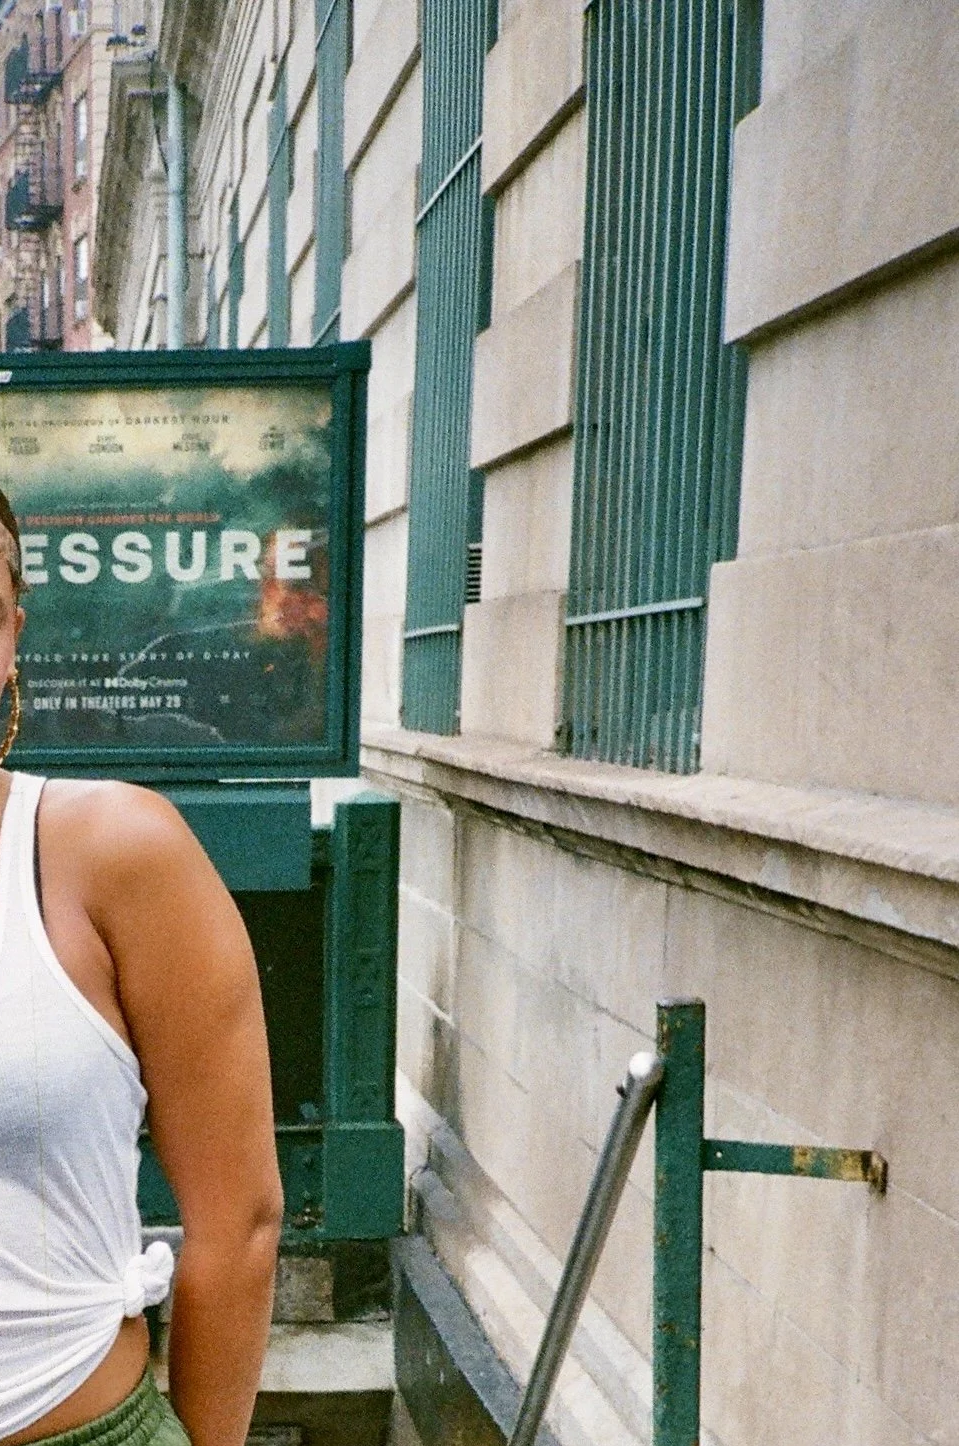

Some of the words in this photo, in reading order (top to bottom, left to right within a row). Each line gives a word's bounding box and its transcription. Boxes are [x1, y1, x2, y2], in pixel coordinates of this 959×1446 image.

[125, 415, 186, 426] DARKEST
[71, 652, 110, 662] TRUE
[120, 652, 167, 662] STORY
[176, 652, 194, 661] OF
[203, 651, 250, 661] D-DAY
[118, 677, 147, 690] Dolby
[33, 697, 61, 711] ONLY
[65, 697, 77, 710] IN
[81, 696, 136, 710] THEATERS
[140, 696, 162, 709] MAY
[166, 695, 181, 709] 29
